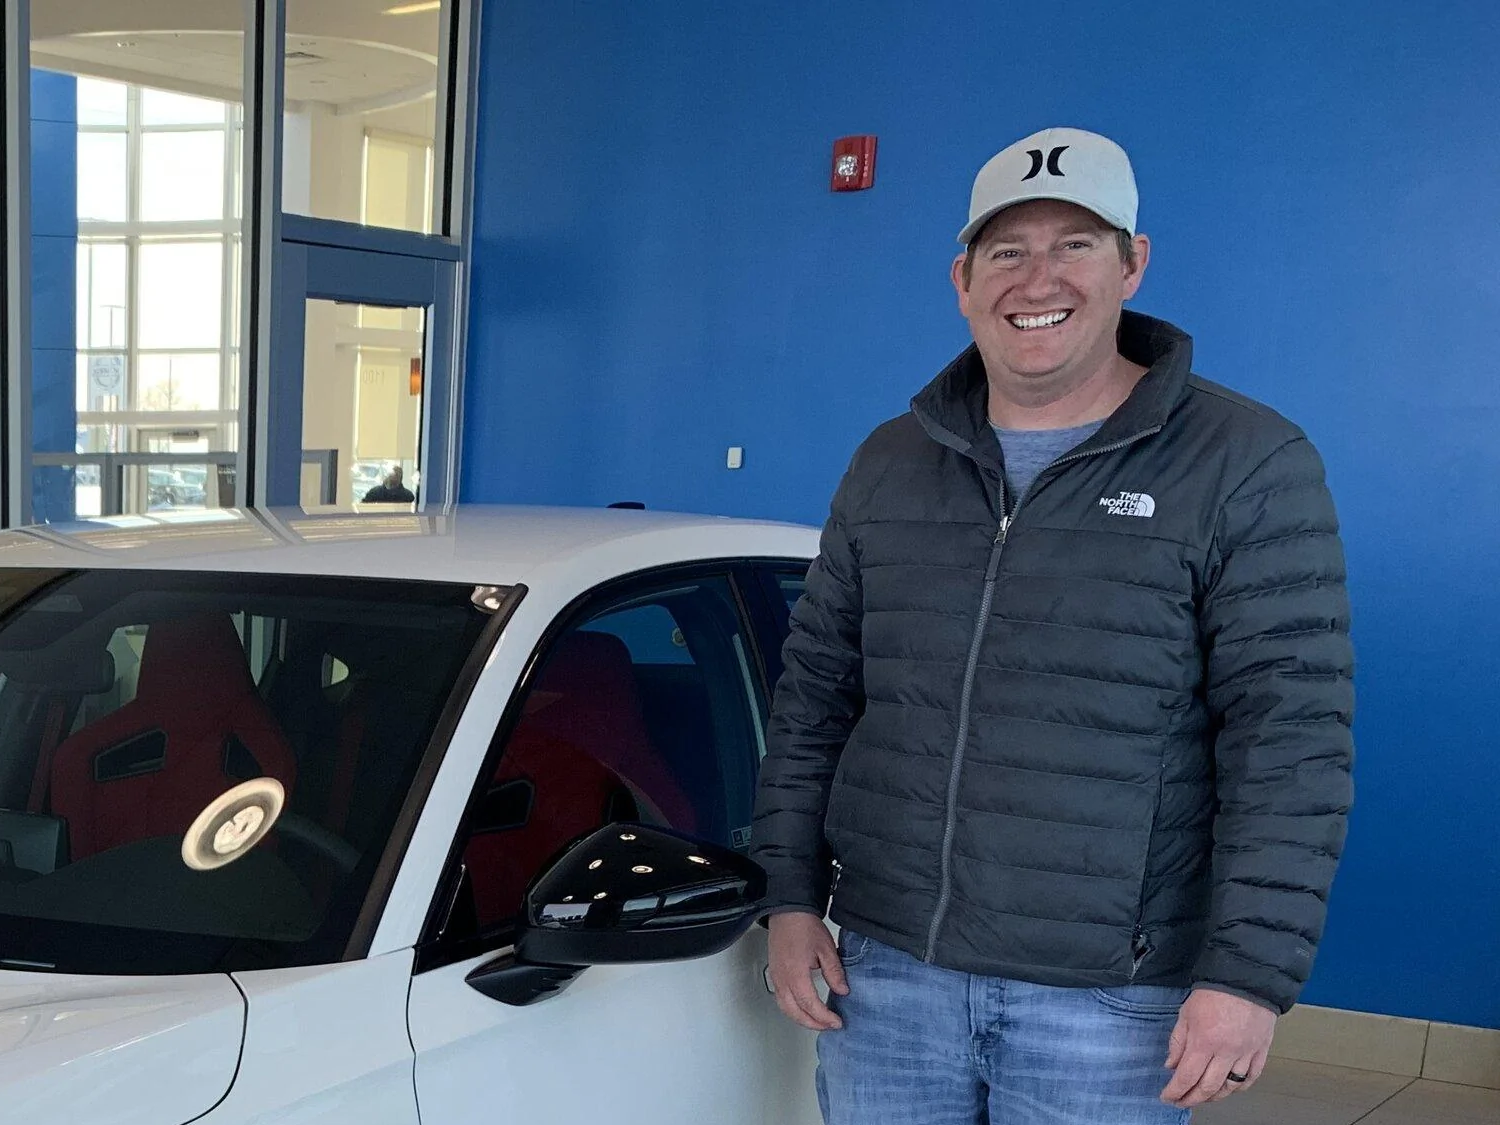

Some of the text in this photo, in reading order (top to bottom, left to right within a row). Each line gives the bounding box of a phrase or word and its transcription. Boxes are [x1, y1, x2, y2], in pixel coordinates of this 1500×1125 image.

[1120, 491, 1141, 502] THE
[1099, 497, 1139, 509] NORTH
[1107, 506, 1137, 517] FACE
